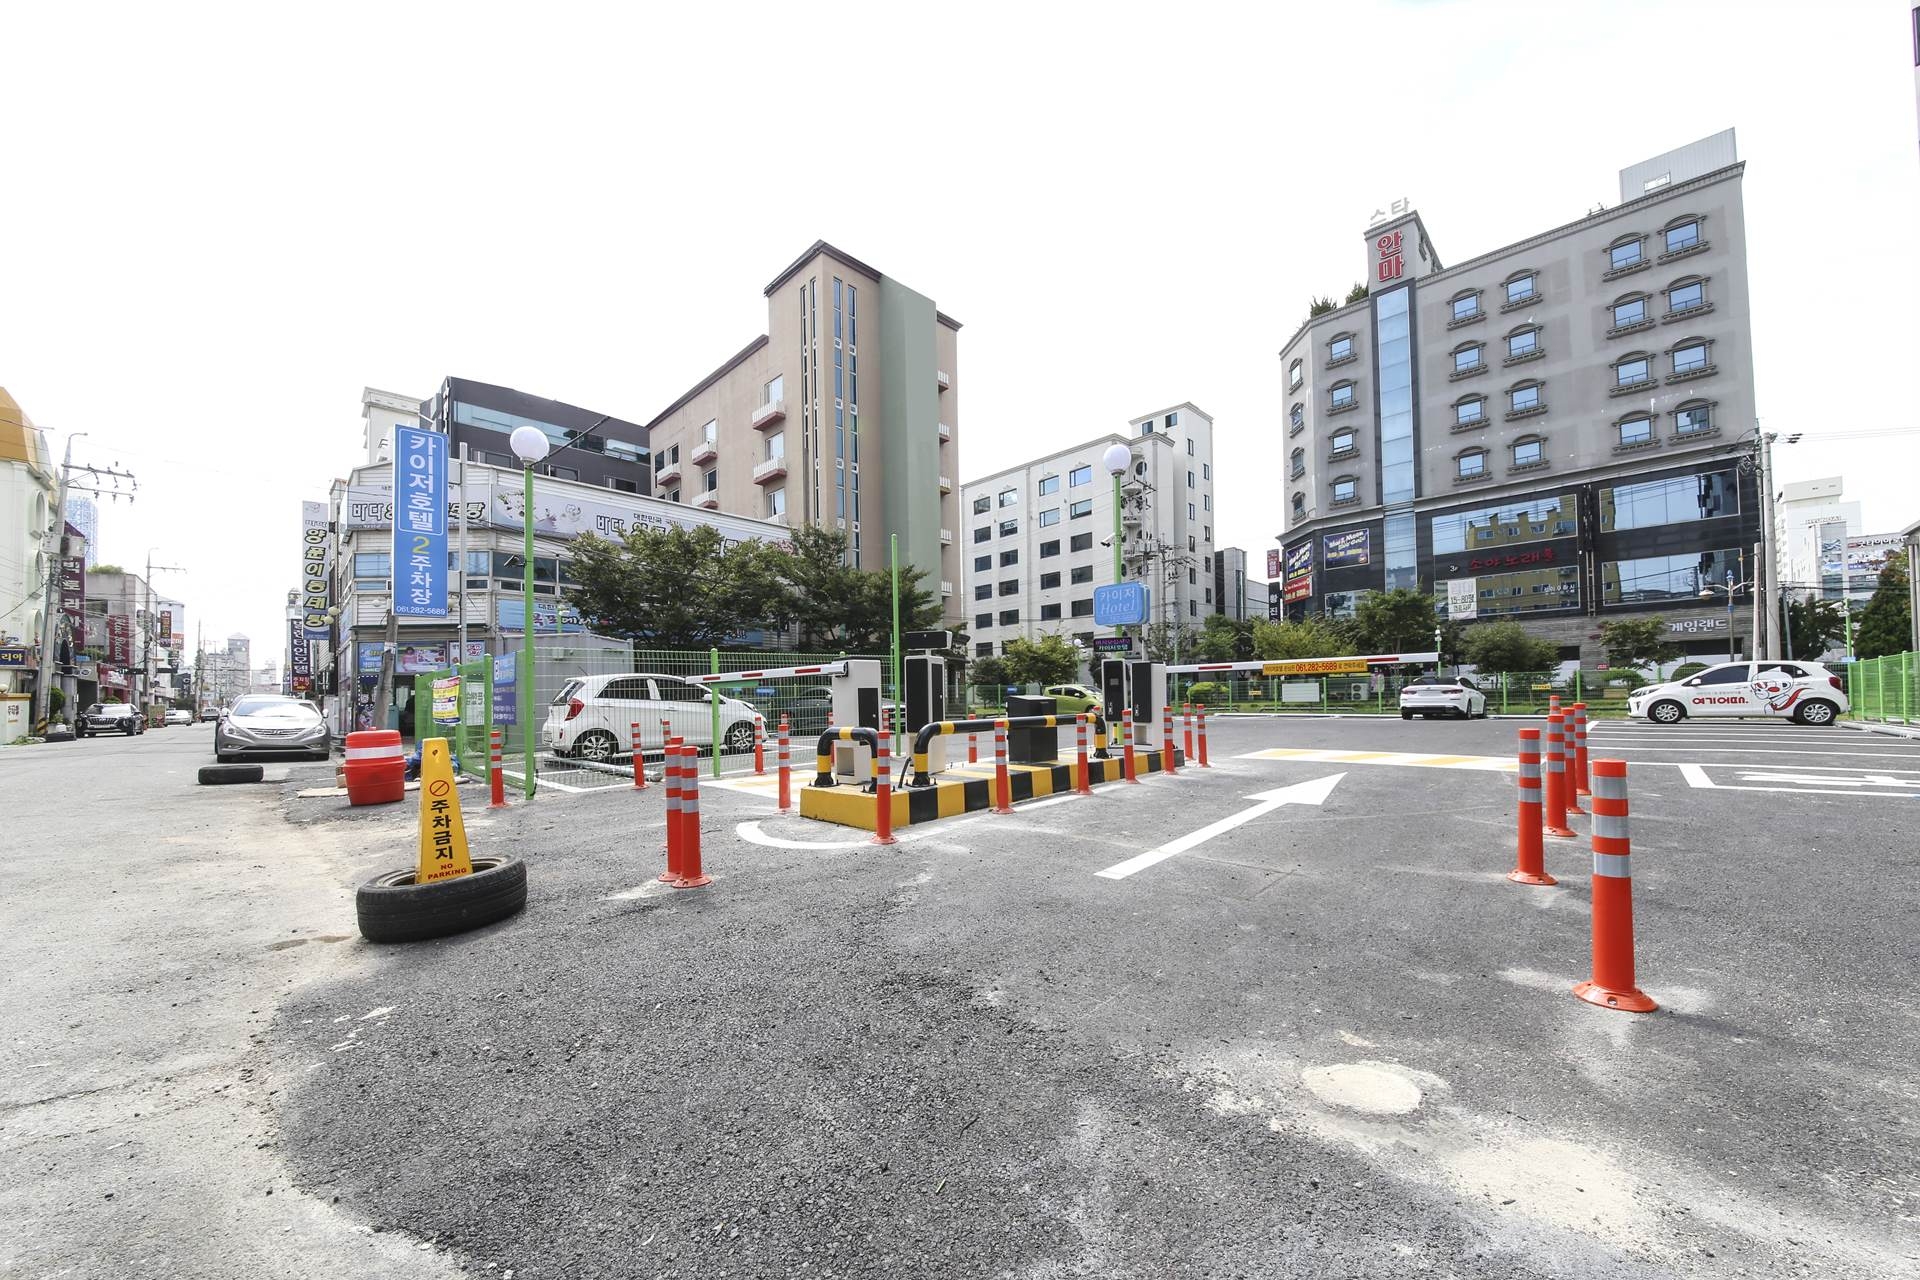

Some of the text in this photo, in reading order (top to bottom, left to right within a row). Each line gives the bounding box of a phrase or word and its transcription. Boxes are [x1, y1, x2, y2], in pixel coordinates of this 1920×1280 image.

[1369, 196, 1410, 228] 스타
[1377, 229, 1404, 282] 안마
[407, 435, 437, 532] 카이저호텔
[352, 503, 384, 521] 바다
[633, 512, 663, 525] 대한민국
[596, 514, 625, 536] 바다
[1099, 587, 1135, 602] 카이저
[1101, 599, 1135, 616] Hotel
[1667, 619, 1728, 633] 게임랜드
[430, 799, 454, 860] 주차금지
[427, 867, 467, 880] PARKING
[440, 862, 453, 870] NO
